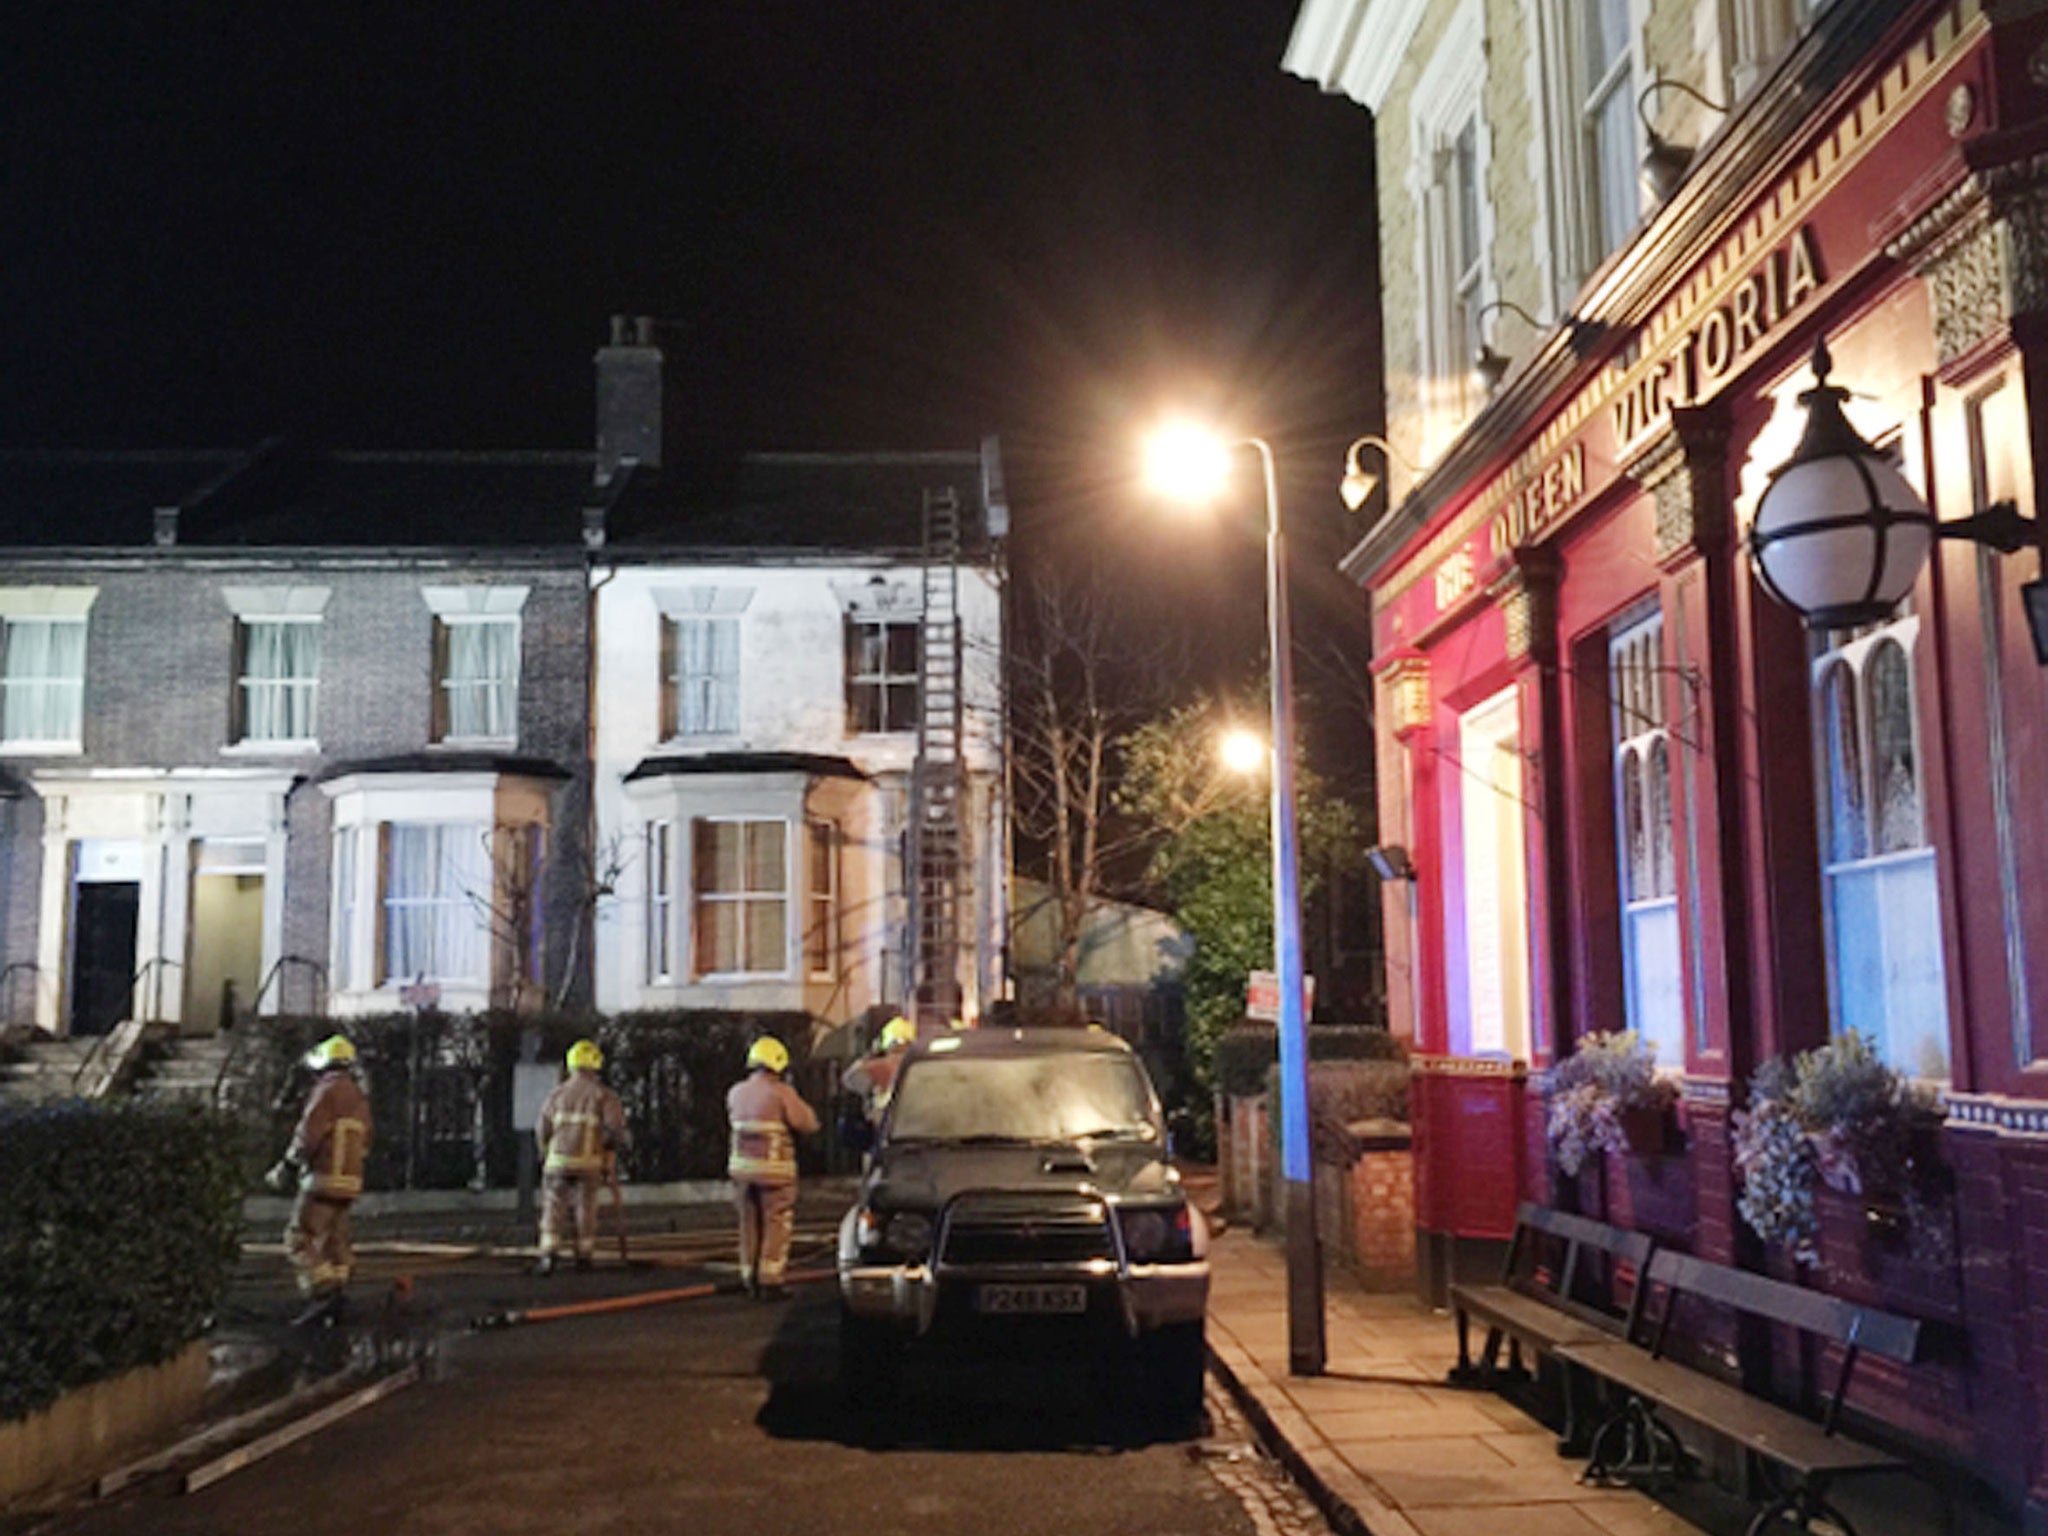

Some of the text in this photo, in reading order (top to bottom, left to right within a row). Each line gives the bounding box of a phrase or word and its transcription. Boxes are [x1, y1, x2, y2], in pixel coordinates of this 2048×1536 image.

[1436, 228, 1822, 611] THE QUEEN VICTORIA
